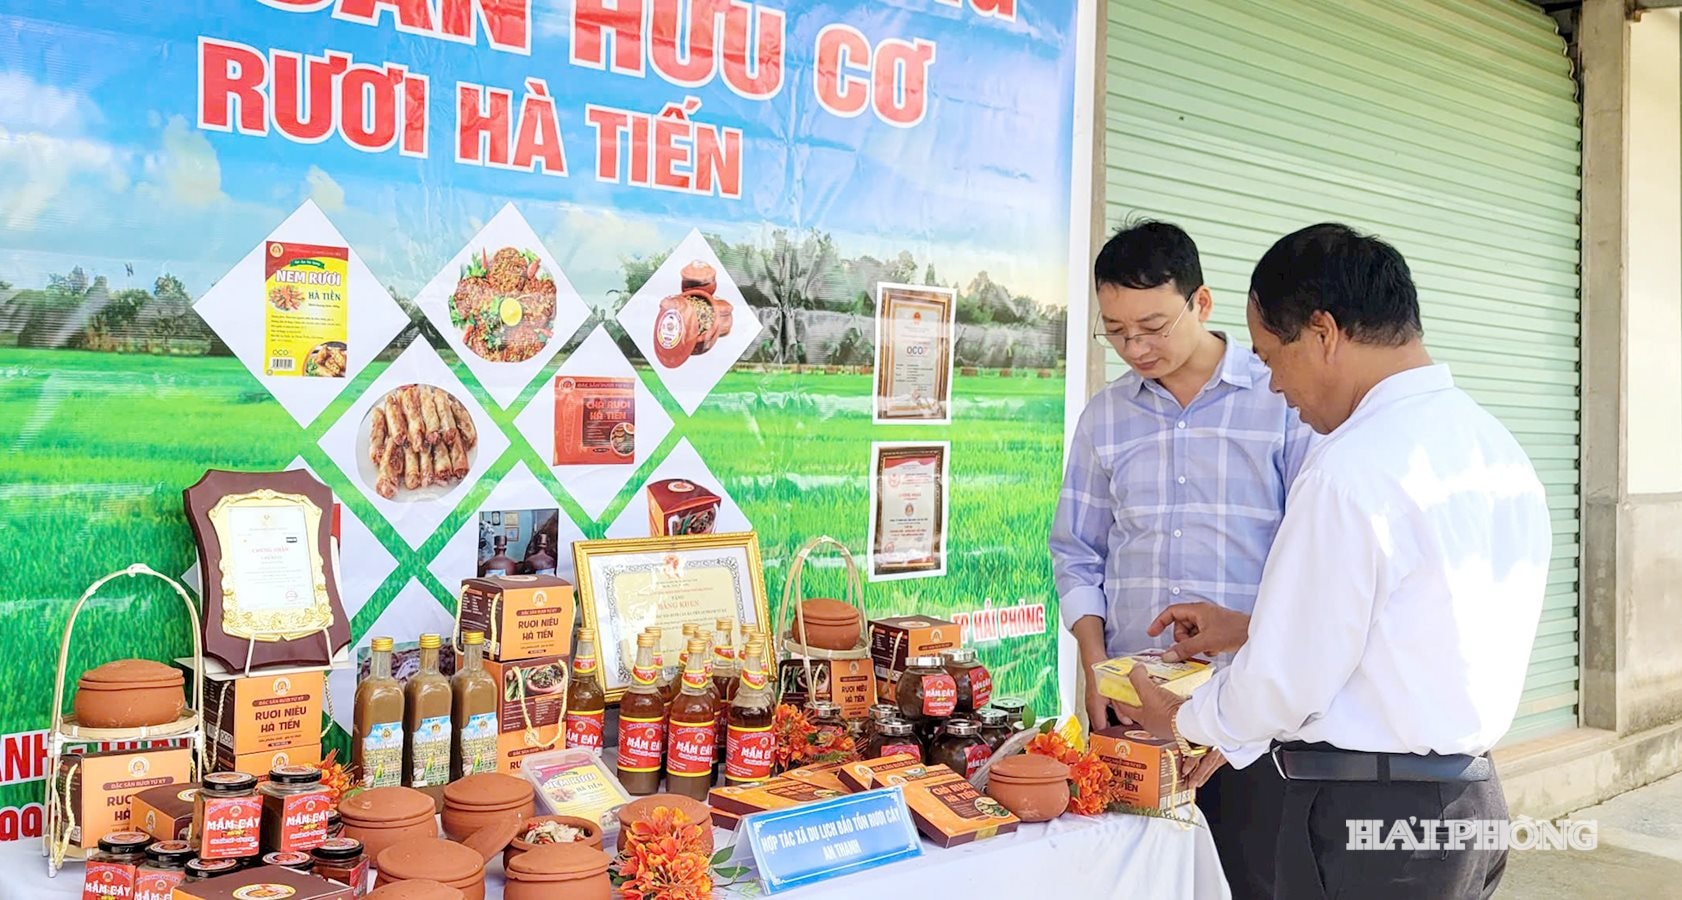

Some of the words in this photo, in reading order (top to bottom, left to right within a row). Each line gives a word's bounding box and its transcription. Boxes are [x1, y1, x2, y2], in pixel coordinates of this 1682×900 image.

[814, 24, 935, 126] CƠ
[199, 38, 428, 156] RƯƠI
[456, 79, 567, 175] HÀ
[587, 97, 742, 197] TIẾN
[275, 269, 306, 284] NEM
[308, 271, 341, 286] RƯƠI
[973, 600, 997, 640] HẢI
[1000, 600, 1045, 638] PHÒNG
[0, 733, 54, 781] NH
[779, 830, 796, 848] TÁC
[795, 826, 808, 845] XÃ
[809, 827, 821, 842] DU
[820, 822, 839, 842] LỊCH
[823, 846, 836, 861] AN
